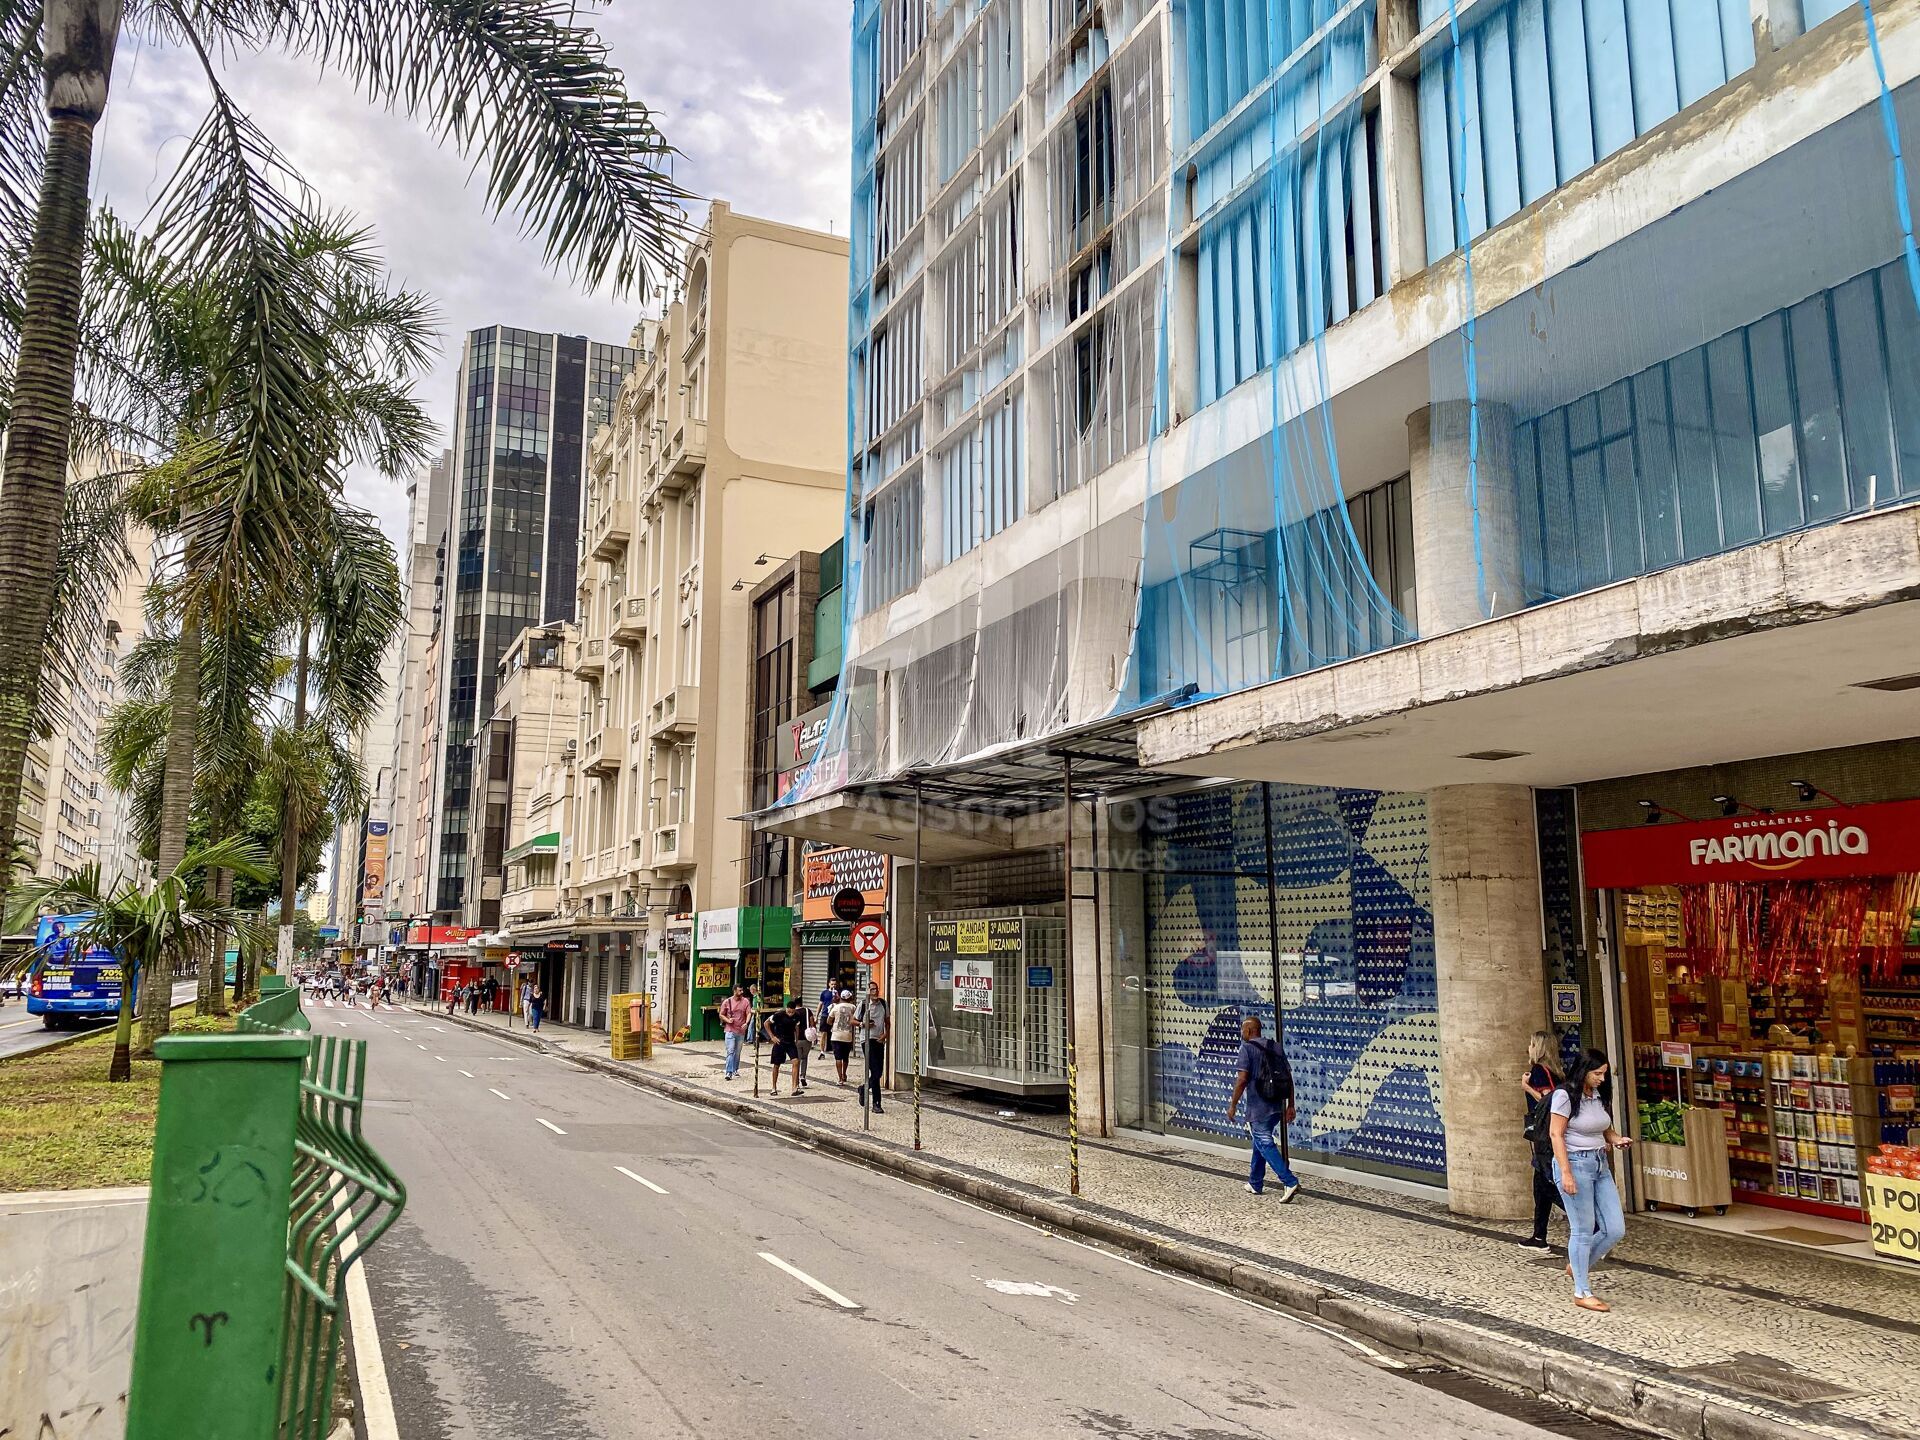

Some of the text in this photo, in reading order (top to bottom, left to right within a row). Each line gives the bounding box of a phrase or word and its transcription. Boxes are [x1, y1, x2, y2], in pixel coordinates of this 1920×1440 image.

[1734, 815, 1813, 828] DROGARIAS
[935, 925, 956, 936] ANDAR
[966, 921, 986, 934] ANDAR
[997, 922, 1020, 933] ANDAR
[960, 935, 985, 944] SOBRELOJA
[989, 939, 1022, 951] MEZANINO
[935, 940, 951, 952] LOJA
[650, 960, 659, 1008] ABERTO
[959, 977, 989, 990] ALUGA
[1867, 1185, 1876, 1206] 1
